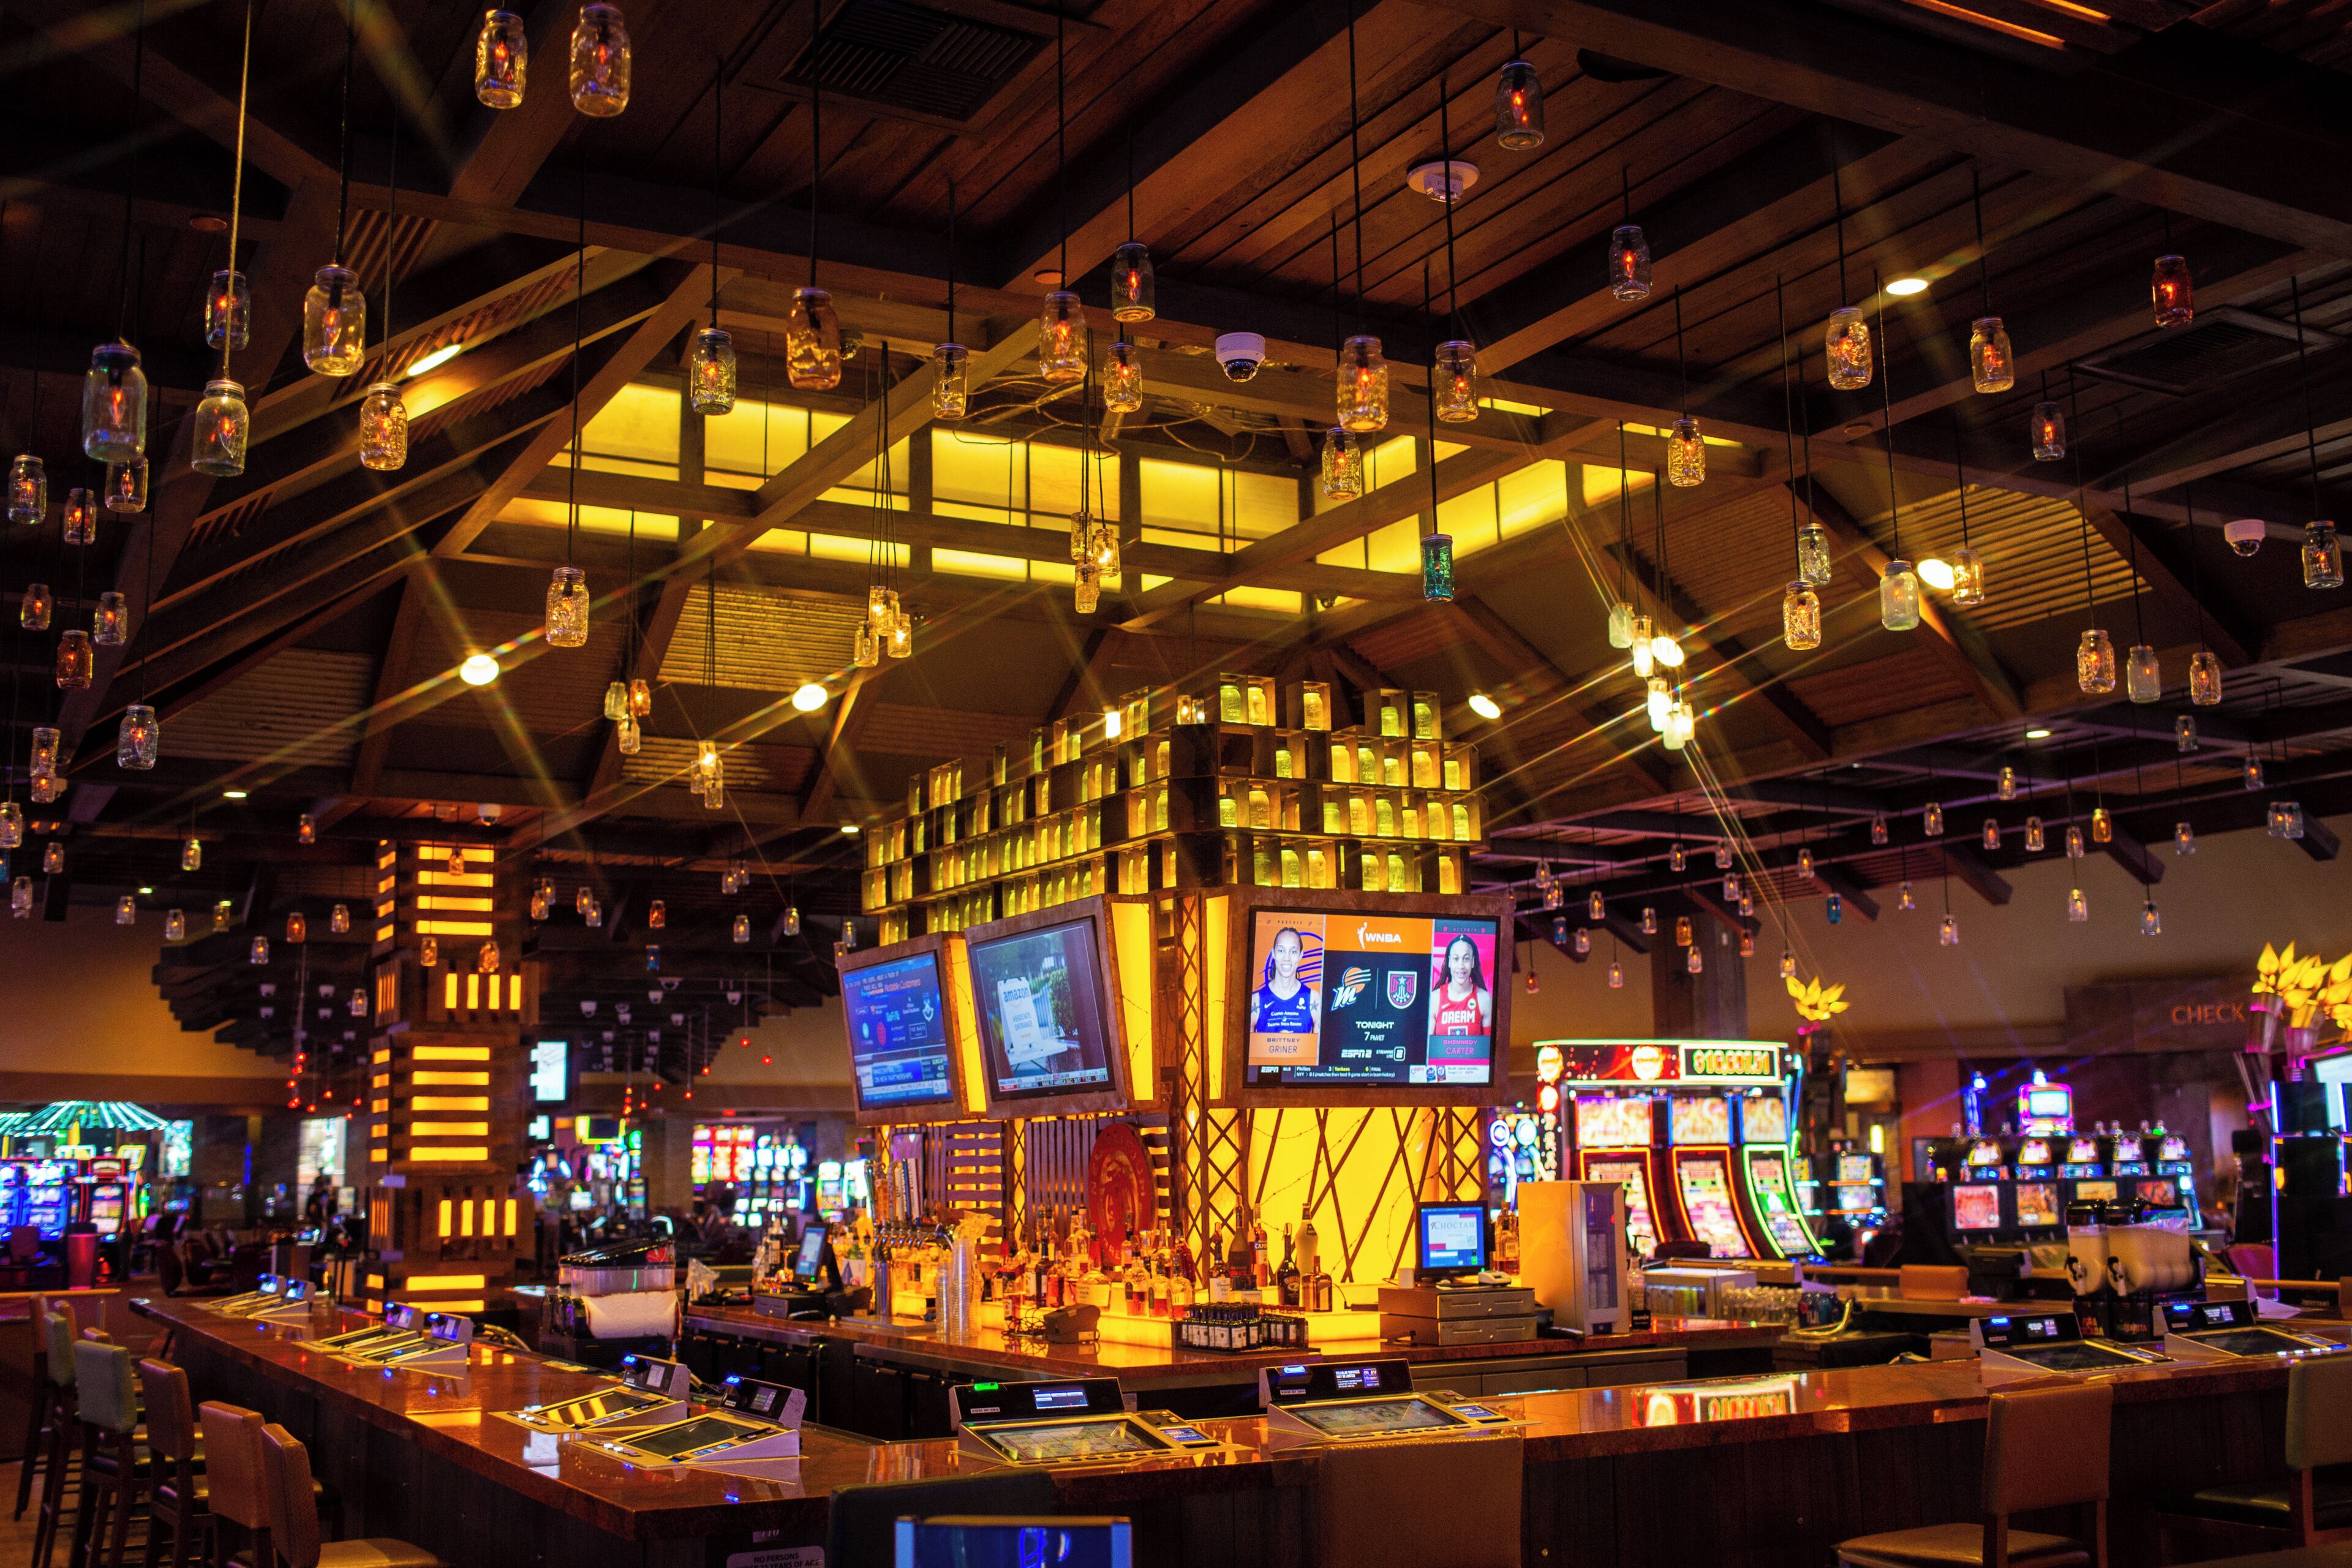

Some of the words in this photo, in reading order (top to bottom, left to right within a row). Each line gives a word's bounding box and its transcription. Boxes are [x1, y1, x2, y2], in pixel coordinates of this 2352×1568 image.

[1365, 933, 1402, 943] WNBA
[1003, 987, 1030, 1003] amazon
[1441, 1010, 1476, 1025] DREAM
[2171, 1002, 2245, 1025] CHECK
[1364, 1031, 1370, 1041] 7
[1434, 1221, 1476, 1230] CHOCTAW
[767, 1553, 799, 1562] PERSONS
